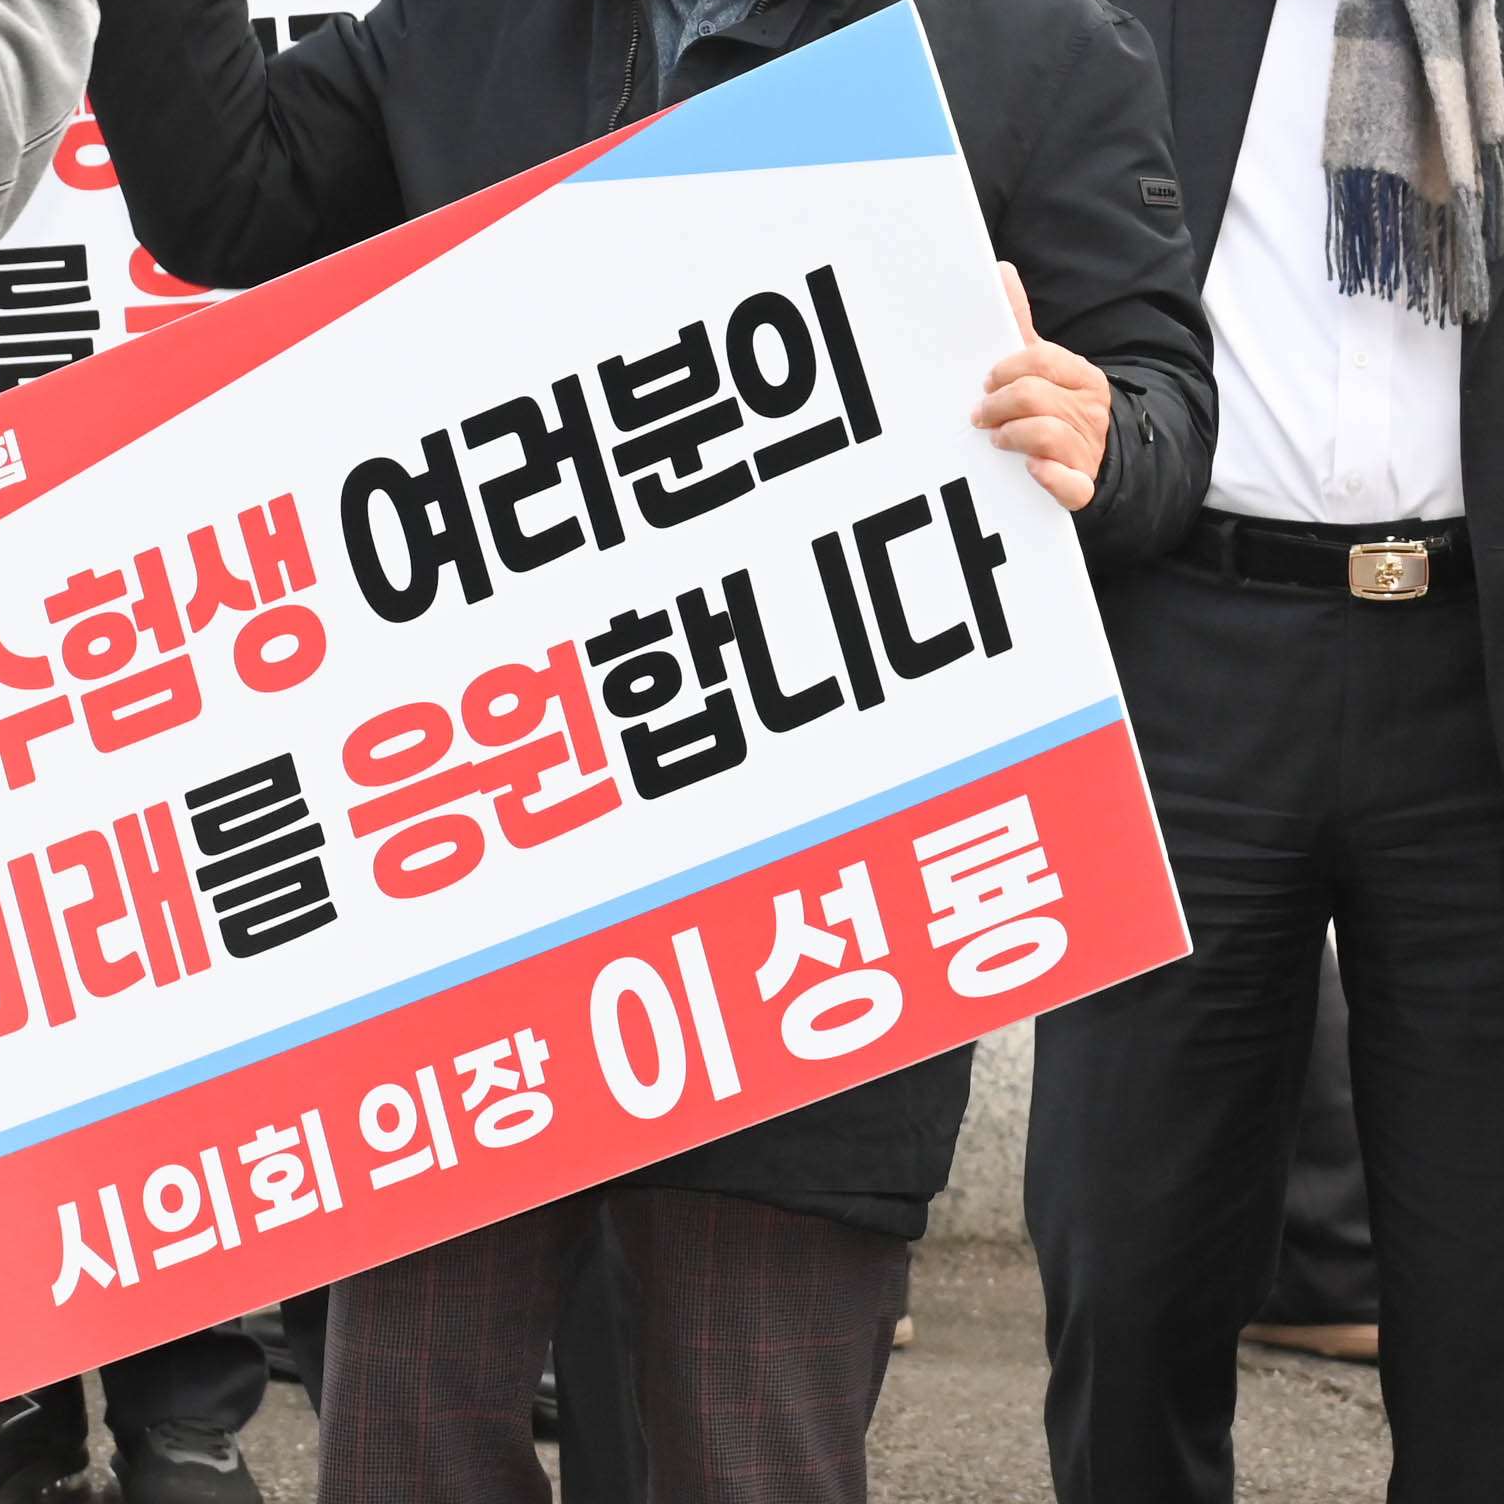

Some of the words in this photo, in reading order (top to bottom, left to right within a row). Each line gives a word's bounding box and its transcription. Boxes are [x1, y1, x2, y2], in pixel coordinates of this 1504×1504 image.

[339, 264, 883, 625] 여러분의
[340, 476, 1015, 900] 응원합니다
[50, 1108, 344, 1305] 시의회
[358, 1026, 554, 1193] 의장
[588, 794, 1069, 1120] 이성룡
